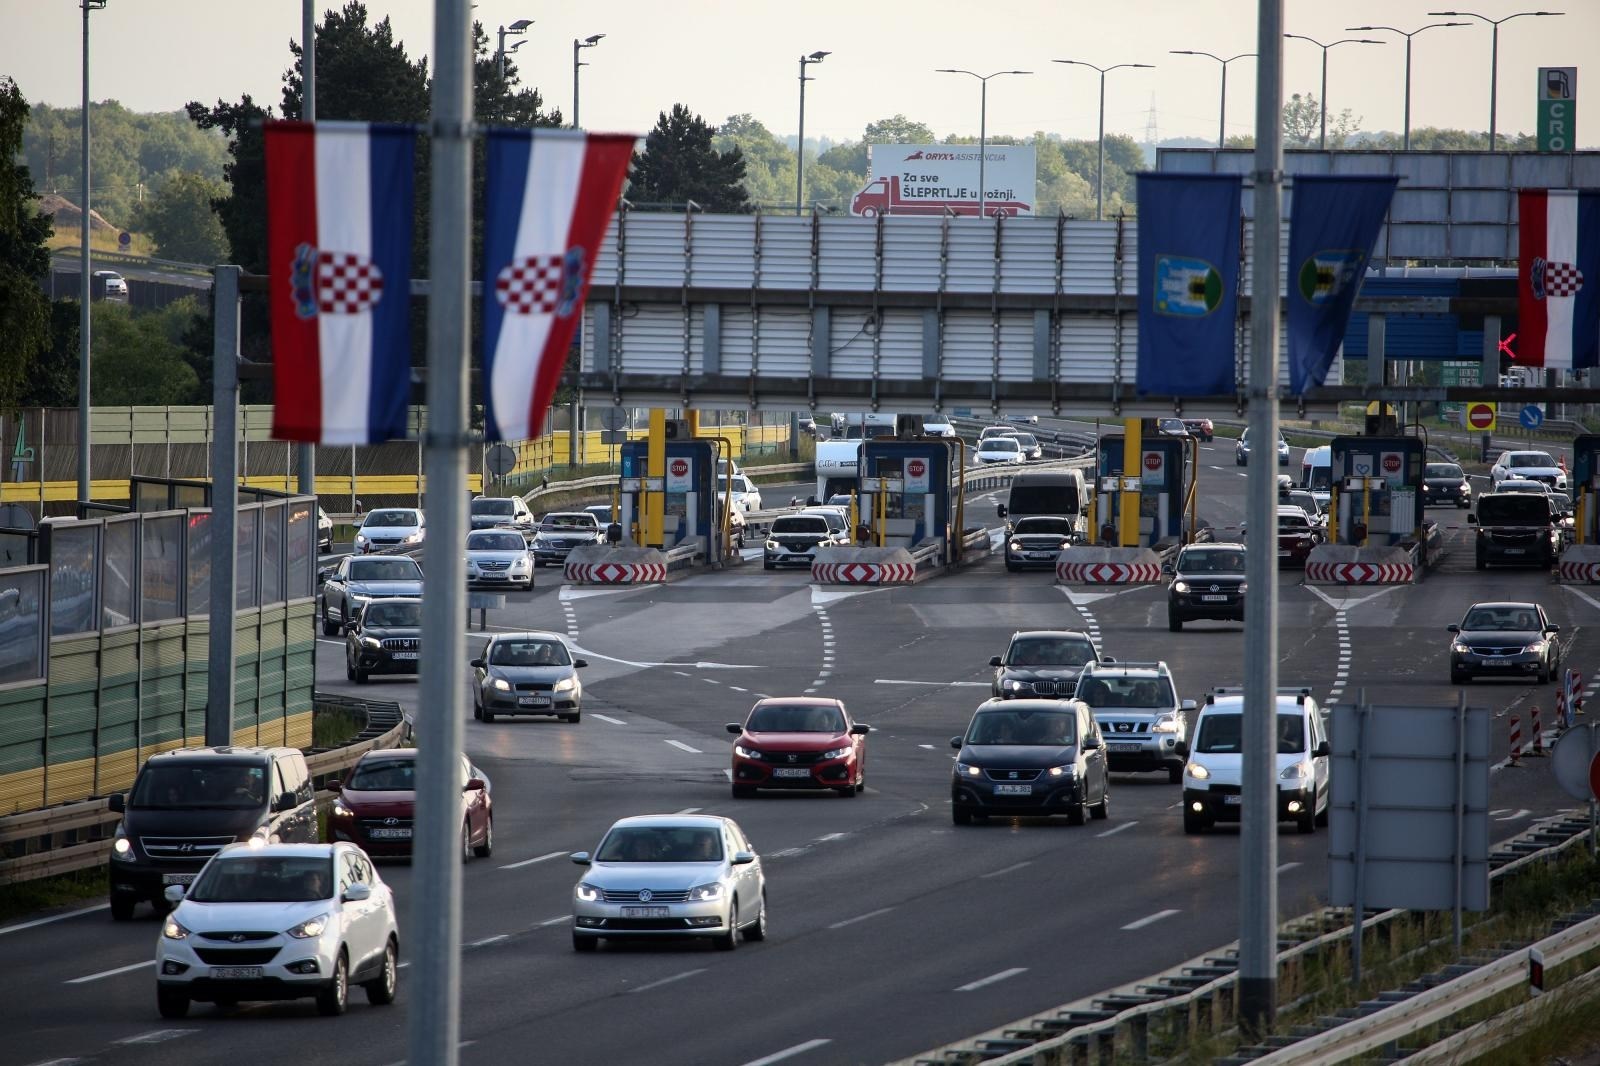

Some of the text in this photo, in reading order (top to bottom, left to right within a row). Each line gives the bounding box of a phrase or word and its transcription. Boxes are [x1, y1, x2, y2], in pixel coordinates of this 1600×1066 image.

[925, 152, 949, 161] ORYX
[903, 172, 939, 183] Za sve
[903, 184, 967, 198] ŠLEPRTLJE
